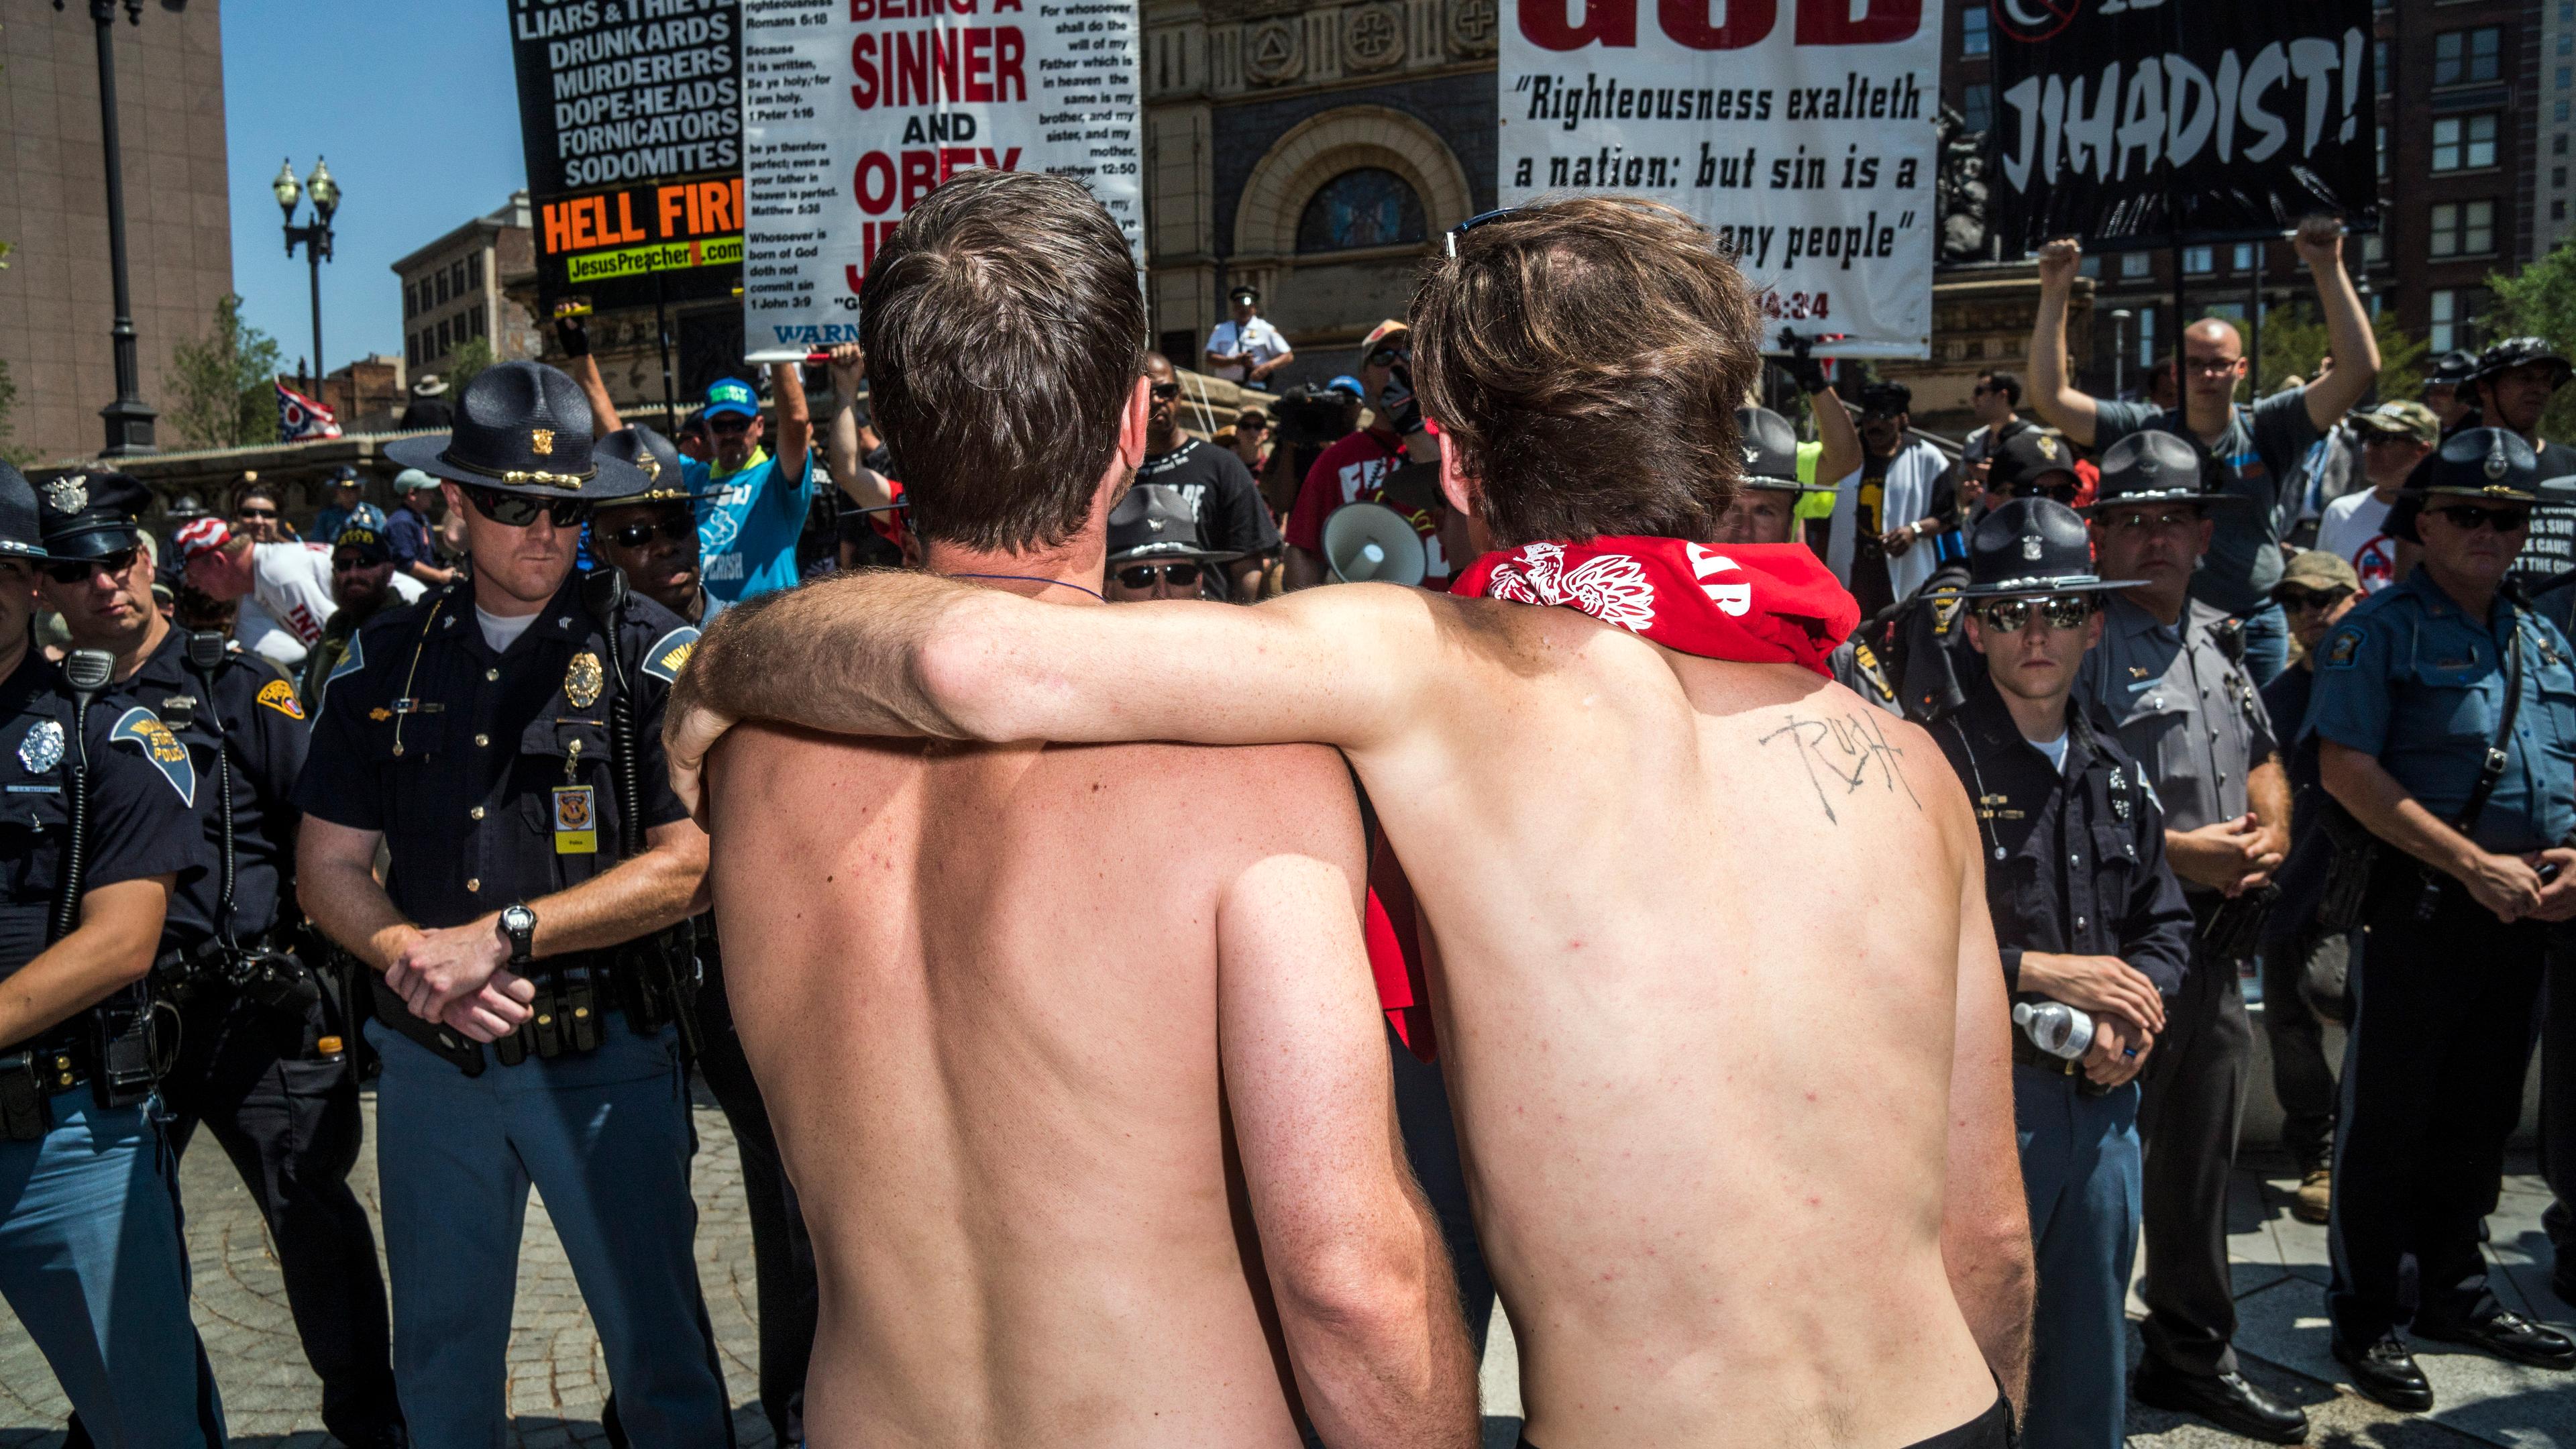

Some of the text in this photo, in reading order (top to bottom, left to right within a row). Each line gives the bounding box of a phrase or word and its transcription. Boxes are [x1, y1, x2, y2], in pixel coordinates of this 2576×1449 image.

[1040, 3, 1131, 17] For whosoever
[517, 1, 600, 40] LIARS
[605, 3, 623, 23] &
[746, 17, 796, 29] Romans
[1056, 20, 1127, 34] shall do the
[549, 12, 731, 69] DRUNKARDS
[1068, 38, 1128, 51] will of my
[746, 46, 794, 56] Because
[747, 62, 754, 72] it
[757, 61, 768, 72] is
[851, 25, 1027, 111] SINNER
[1040, 56, 1132, 71] Father which is
[553, 44, 733, 100] MURDERERS
[747, 78, 762, 89] Be
[767, 79, 780, 90] ye
[814, 74, 831, 85] for
[1043, 73, 1128, 89] in heaven the
[748, 96, 752, 106] I
[755, 96, 773, 105] am
[1063, 93, 1134, 105] same is my
[1786, 71, 1919, 121] exalteth
[555, 77, 737, 130] DOPE-HEADS
[757, 109, 788, 121] Peter
[1040, 110, 1134, 125] brother, and my
[2003, 27, 2364, 195] JIHADIST!
[559, 107, 739, 159] FORNICATORS
[902, 112, 977, 144] AND
[1046, 127, 1131, 143] sister, and my
[750, 142, 827, 155] be ye therefore
[1090, 146, 1136, 158] mother.
[565, 138, 738, 187] SODOMITES
[793, 160, 816, 168] even
[819, 158, 830, 166] as
[1101, 162, 1136, 175] 12:50
[1514, 142, 1918, 189] a nation: but sin is a
[751, 173, 818, 186] your father in
[751, 189, 786, 201] heaven
[789, 189, 797, 199] is
[751, 205, 793, 216] Matthew
[542, 192, 646, 254] HELL
[750, 230, 826, 244] Whosoever is
[749, 246, 818, 260] born of God
[749, 265, 798, 277] doth not
[750, 280, 814, 293] commit sin
[751, 297, 811, 310] 1 John 3:9
